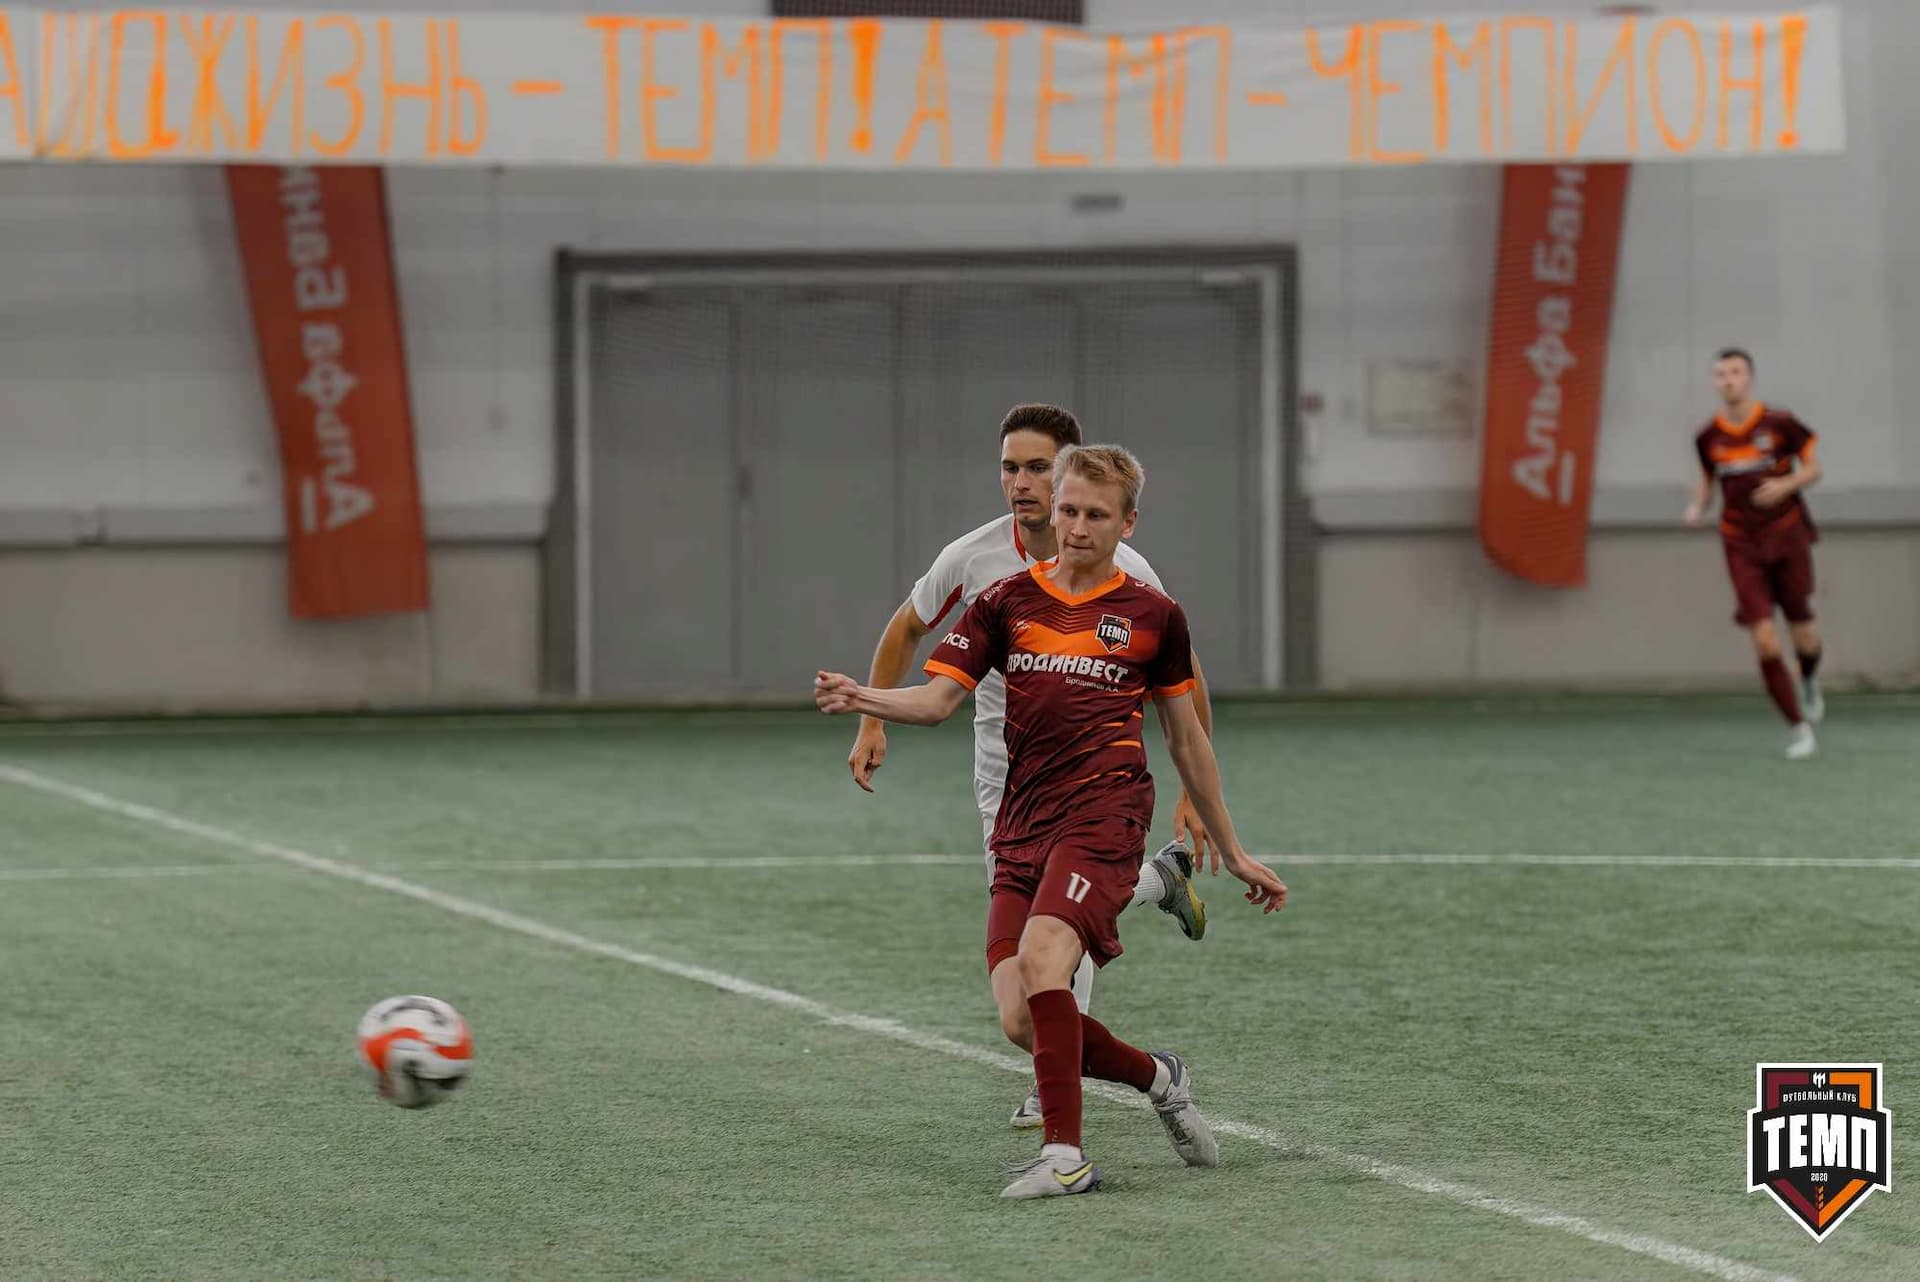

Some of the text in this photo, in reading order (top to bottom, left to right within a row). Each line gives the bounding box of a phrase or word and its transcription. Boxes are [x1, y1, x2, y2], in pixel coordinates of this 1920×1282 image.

[179, 13, 488, 157] ЖИЗНЬ
[585, 15, 883, 163] ТЕМП!
[893, 18, 953, 166] А
[983, 21, 1231, 166] ТЕМП
[1304, 14, 1808, 163] ЧЕМПИОН!
[1512, 296, 1578, 504] Альфа
[1100, 624, 1129, 644] ТЕМП
[1066, 872, 1091, 903] 17
